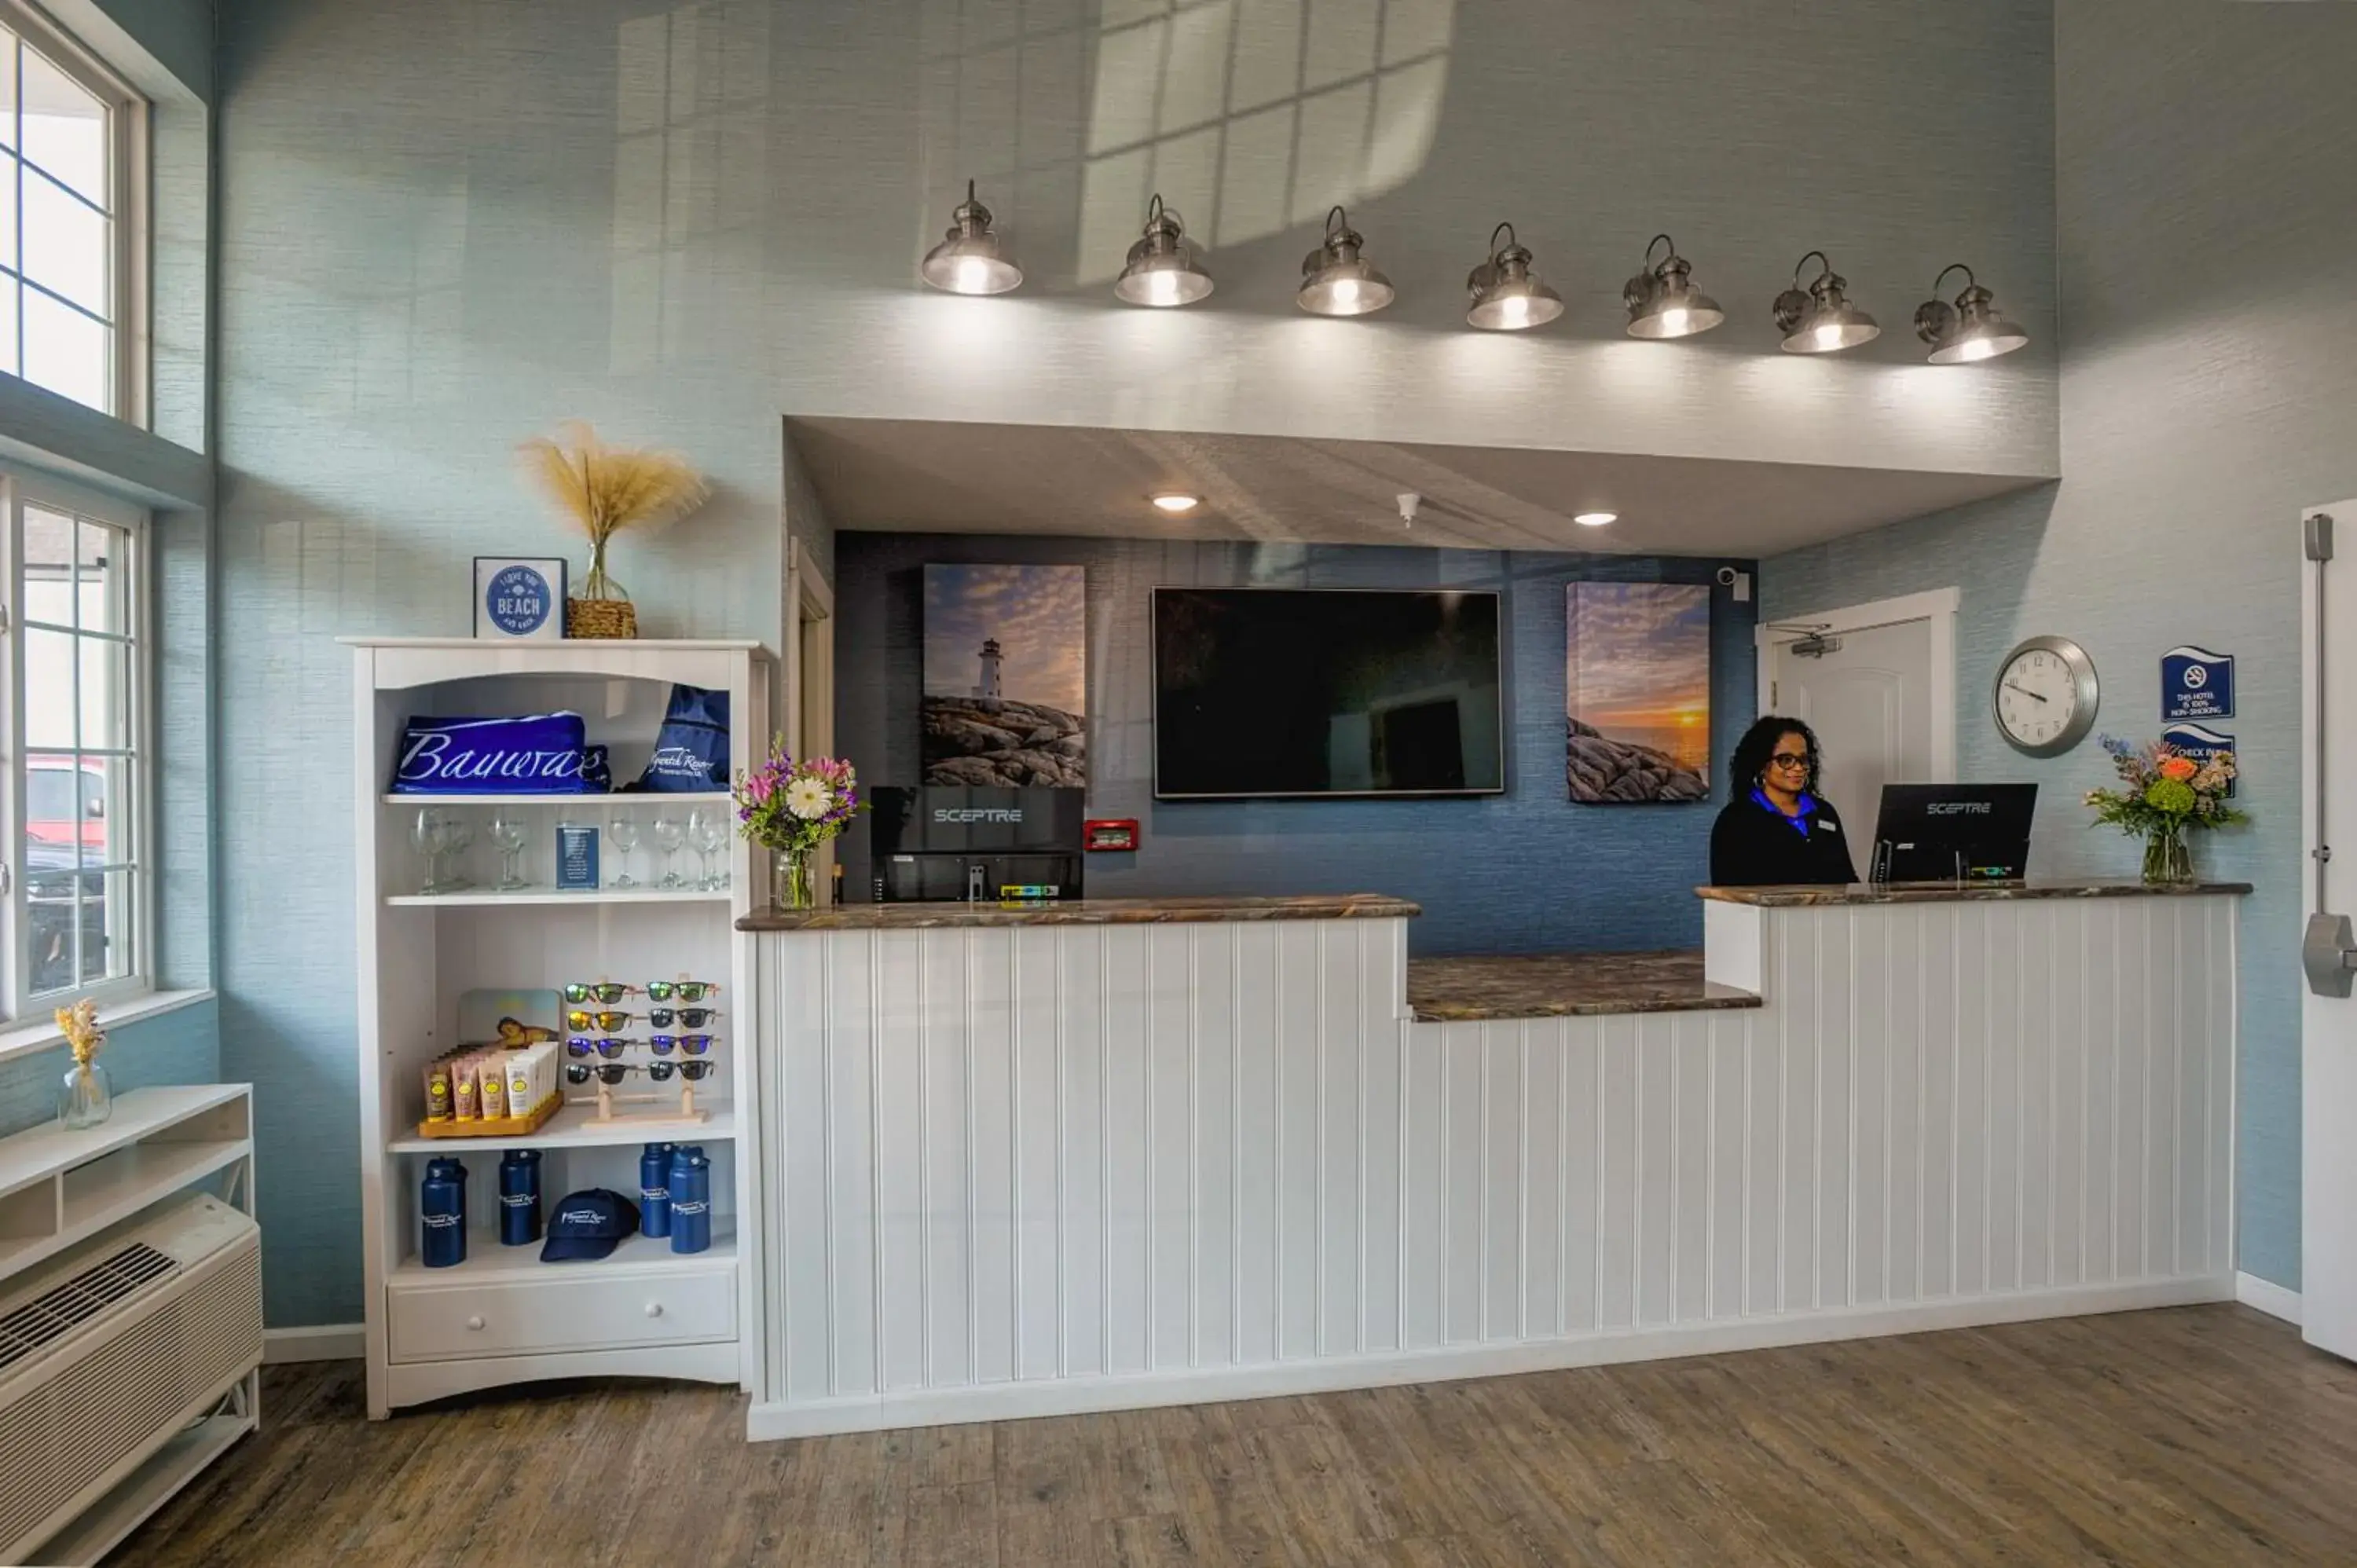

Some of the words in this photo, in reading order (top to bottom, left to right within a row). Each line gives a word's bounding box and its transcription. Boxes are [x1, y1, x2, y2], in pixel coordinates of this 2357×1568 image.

[497, 598, 540, 615] BEACH
[2193, 691, 2214, 700] HOTEL
[2171, 705, 2223, 717] NON-SMOKING
[934, 808, 1022, 822] SCEPTRE
[1926, 802, 1992, 815] SCEPTRE
